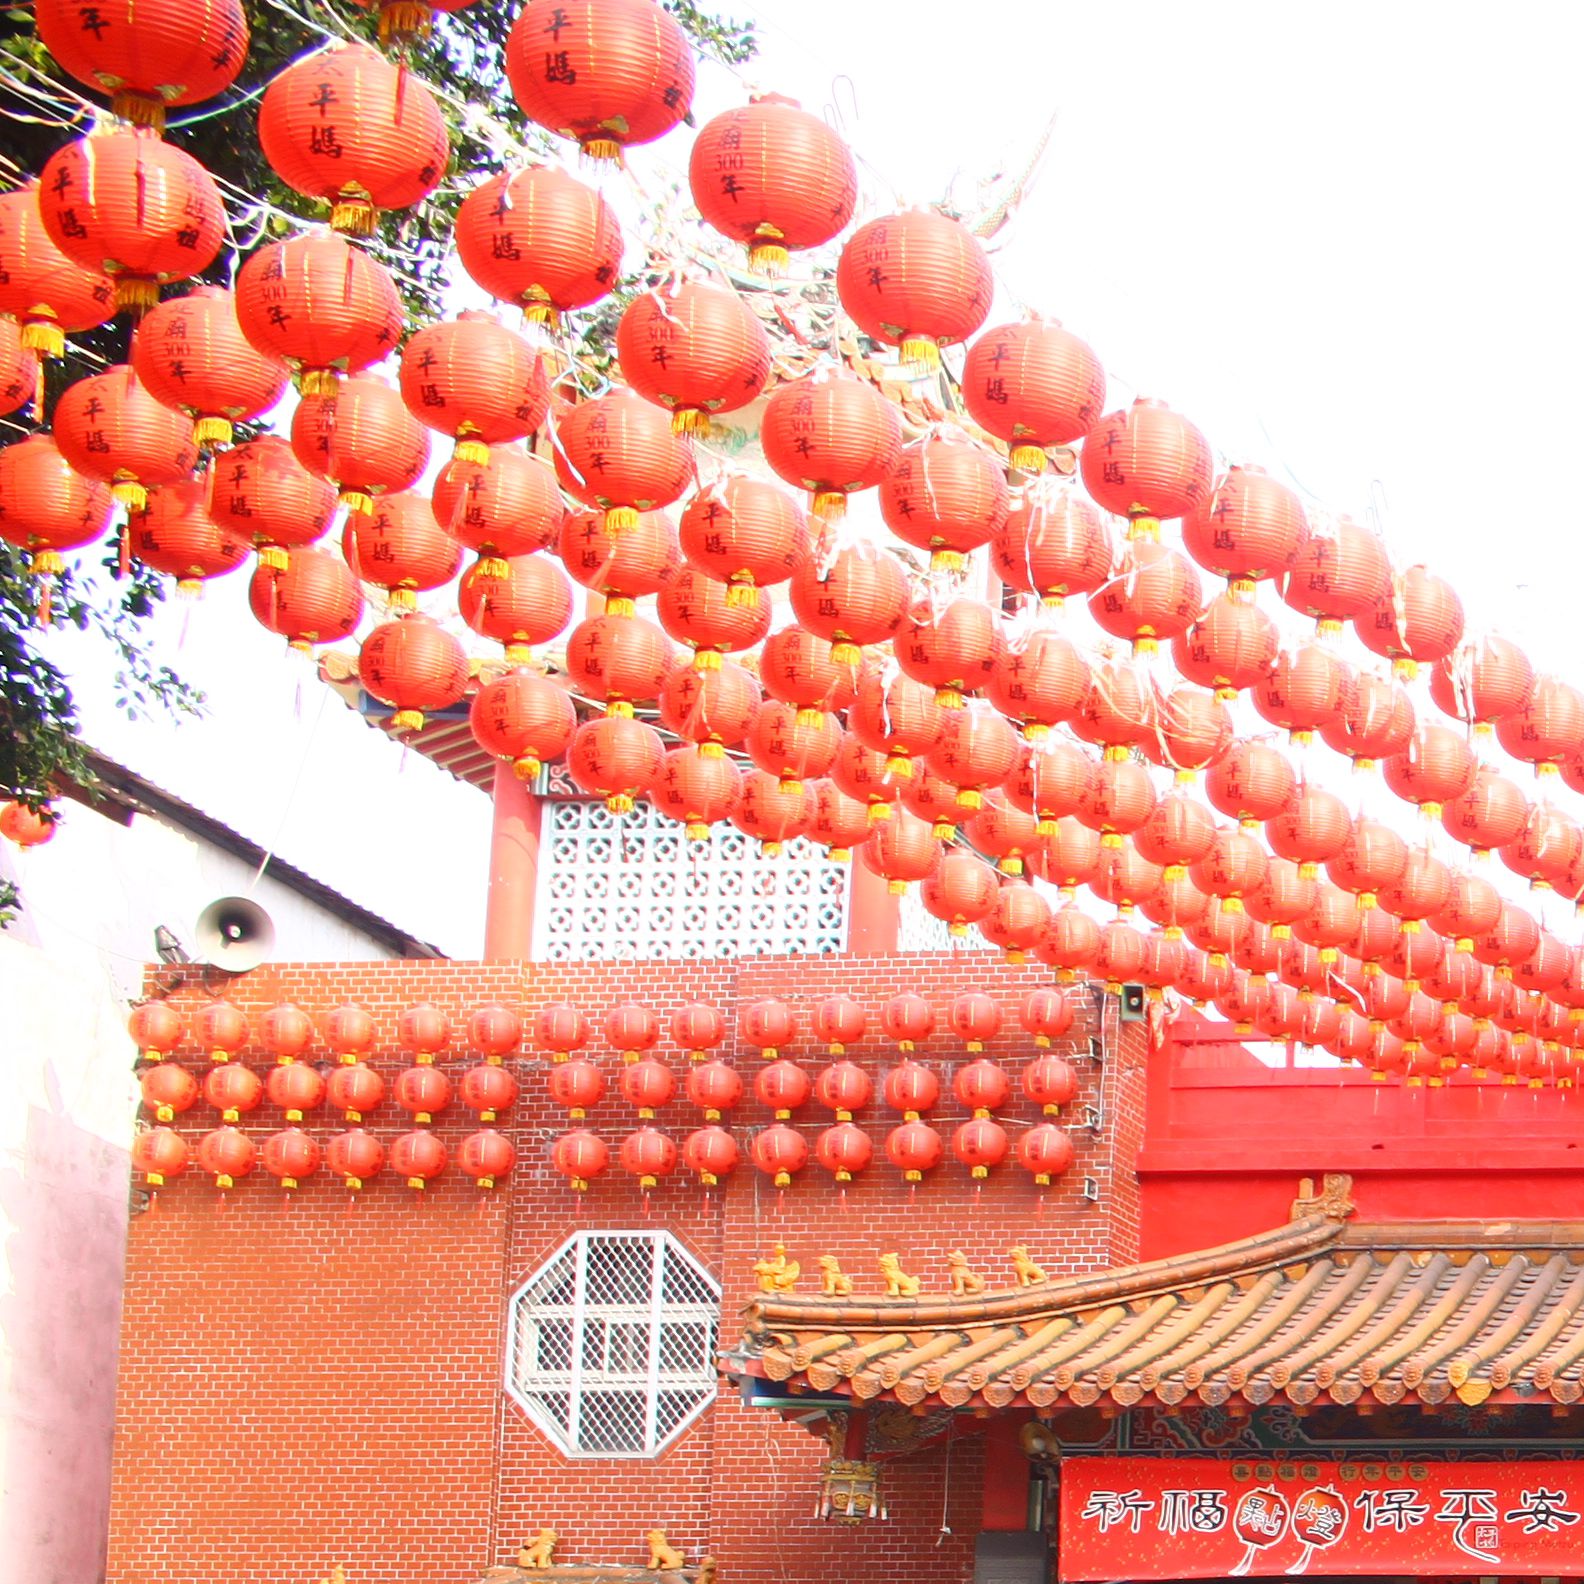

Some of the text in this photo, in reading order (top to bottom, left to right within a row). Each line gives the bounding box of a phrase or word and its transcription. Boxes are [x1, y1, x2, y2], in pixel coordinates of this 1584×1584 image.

[1082, 1487, 1581, 1563] 祈福點燈保平安
